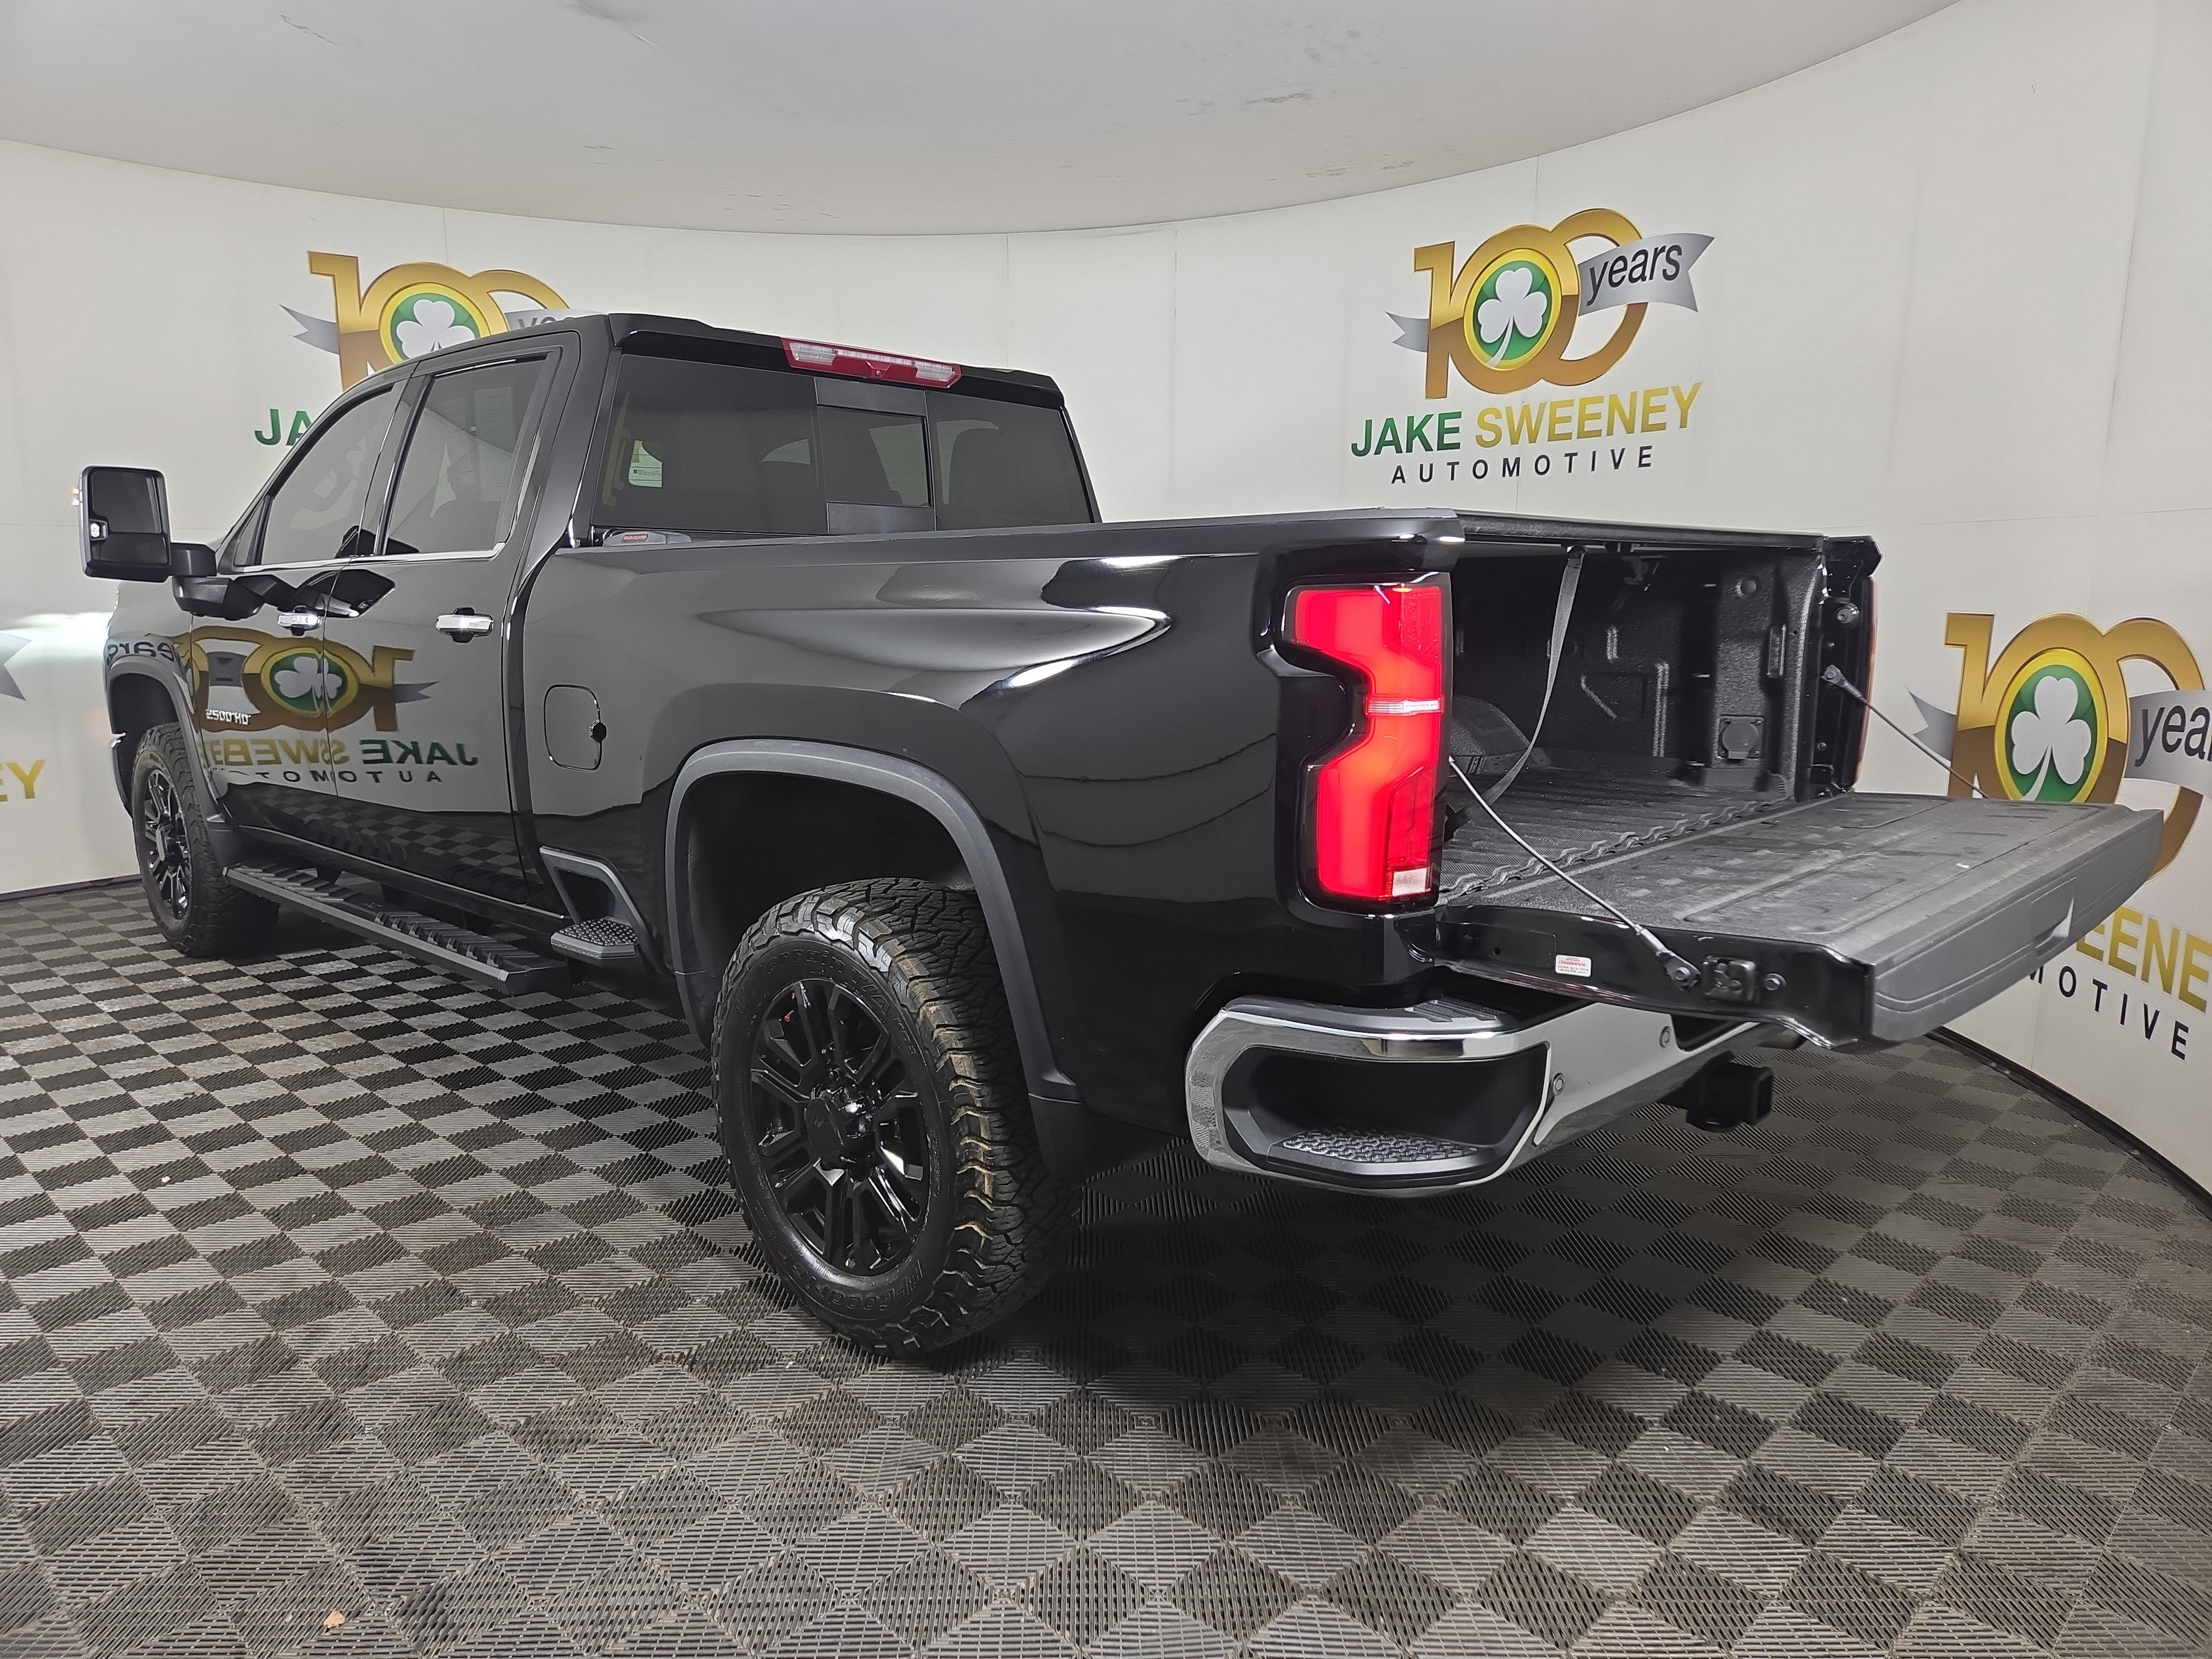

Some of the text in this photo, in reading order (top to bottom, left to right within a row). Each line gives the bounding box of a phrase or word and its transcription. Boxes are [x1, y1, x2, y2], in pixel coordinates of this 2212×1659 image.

[1414, 208, 1650, 400] 100
[1586, 243, 1682, 305] years
[254, 408, 312, 446] JA
[1351, 382, 1702, 458] JAKE SWEENEY
[1391, 445, 1653, 485] AUTOMOTIVE
[205, 709, 233, 723] 2500
[2134, 705, 2212, 767] yea
[2076, 906, 2212, 1013] EENE
